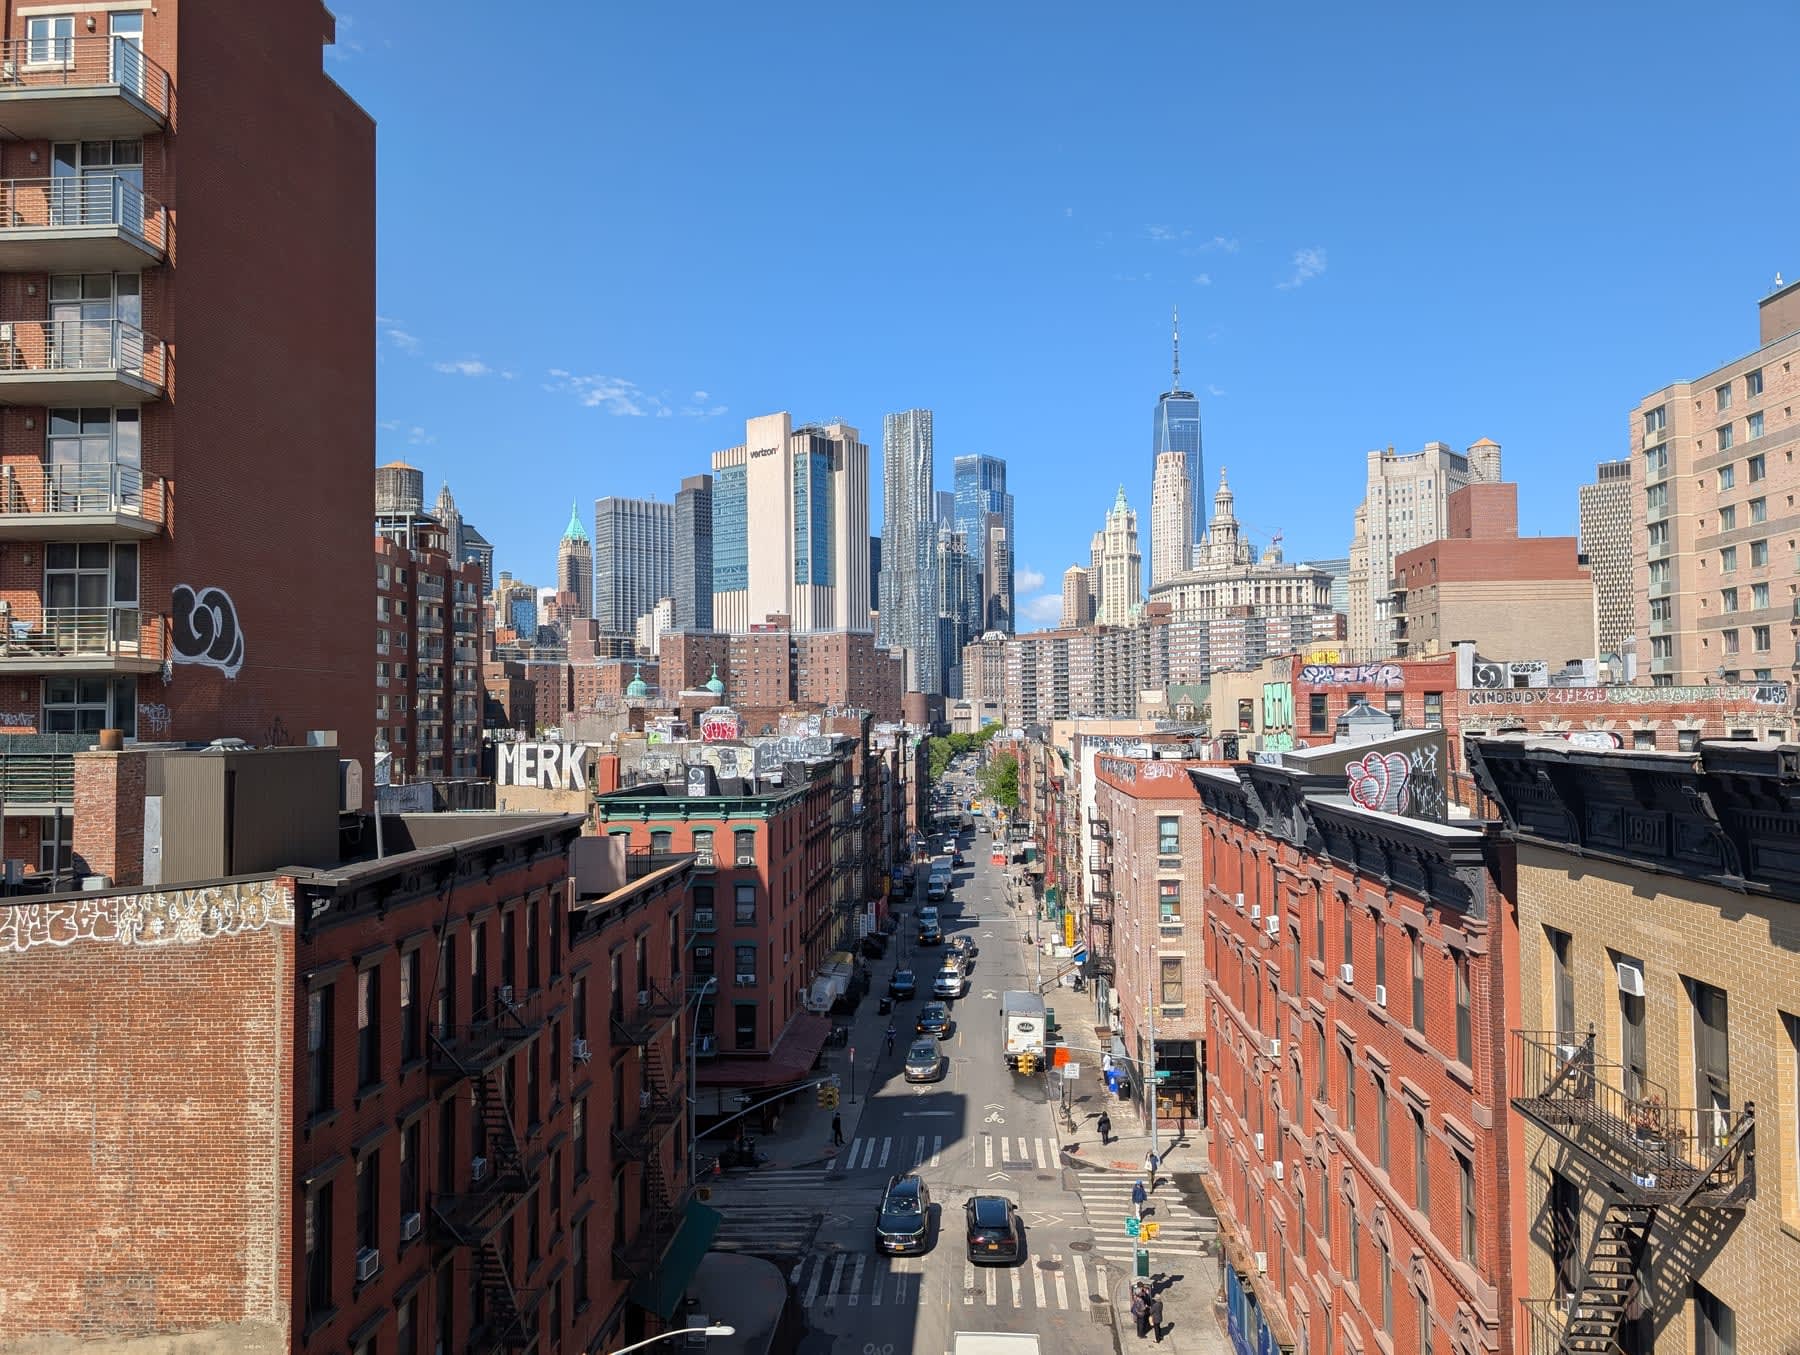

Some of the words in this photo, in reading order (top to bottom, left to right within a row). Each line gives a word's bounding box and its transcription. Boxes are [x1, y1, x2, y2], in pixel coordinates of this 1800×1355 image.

[750, 447, 777, 459] verizon
[1469, 690, 1535, 705] KINDBUD
[497, 743, 587, 792] MERK
